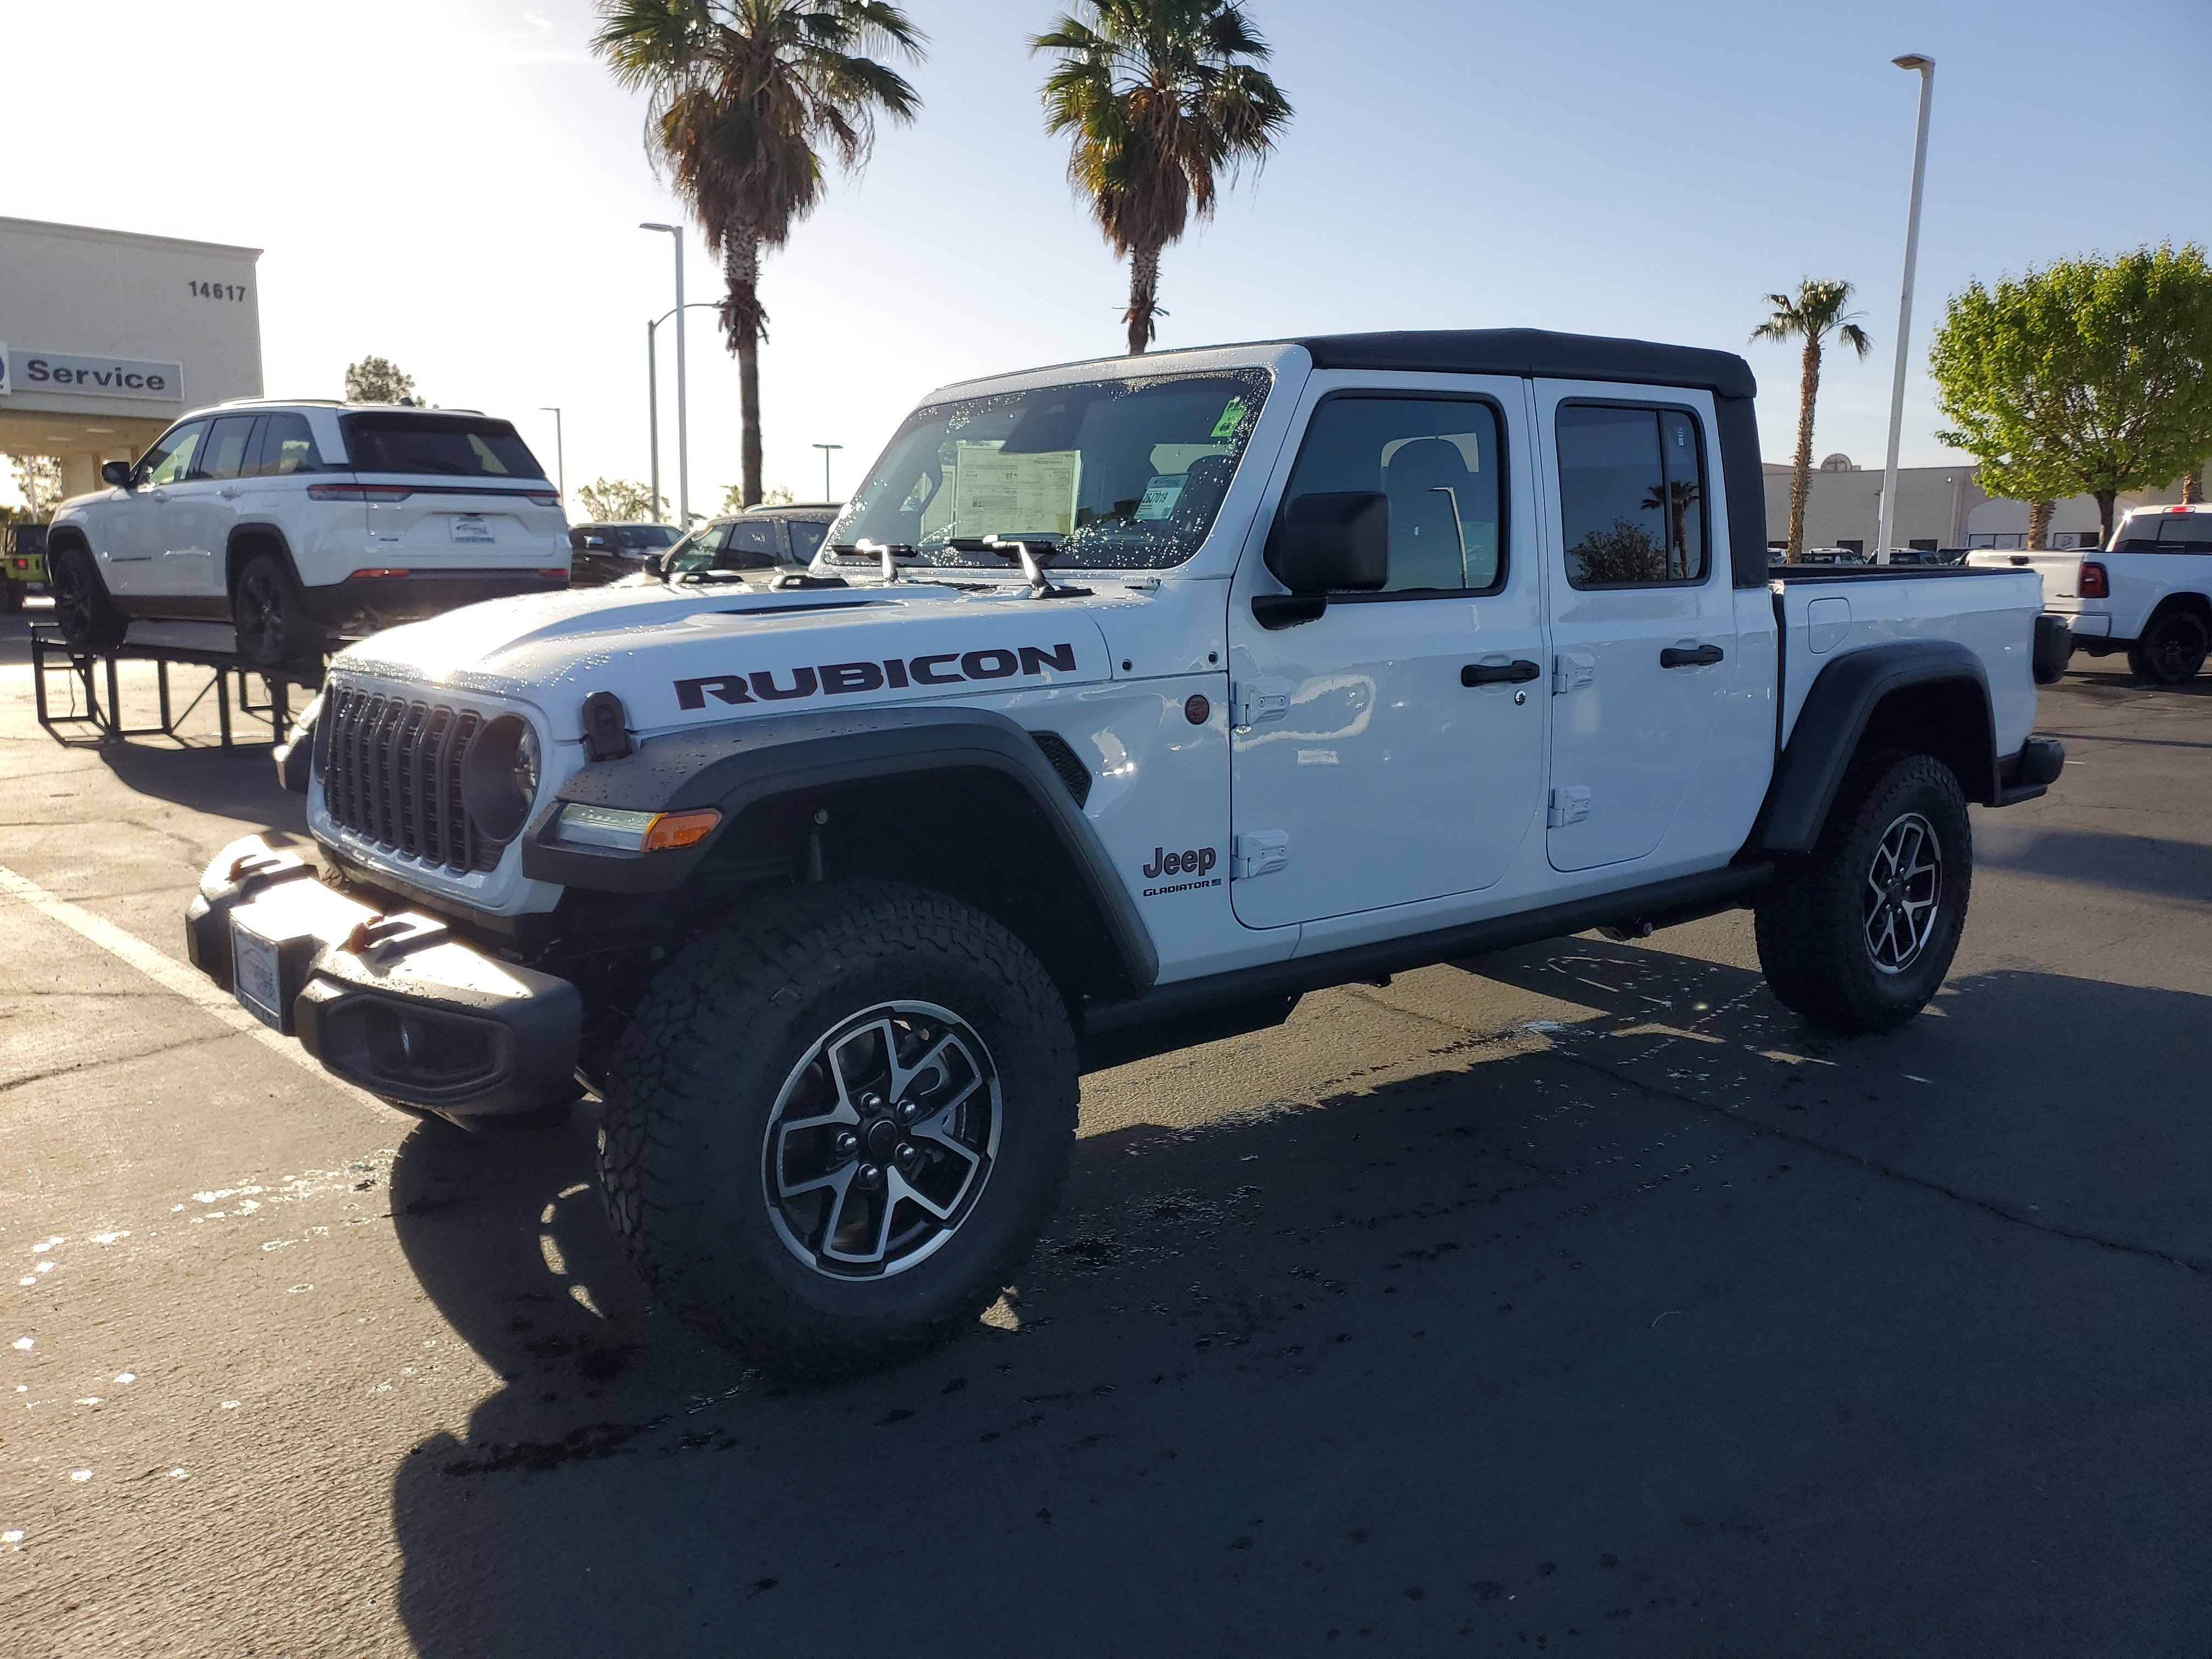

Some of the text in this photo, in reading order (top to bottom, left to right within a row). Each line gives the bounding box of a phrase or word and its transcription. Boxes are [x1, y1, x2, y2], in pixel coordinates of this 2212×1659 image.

[189, 281, 246, 302] 14617
[27, 359, 165, 391] Service
[673, 643, 1077, 710] RUBICON
[1143, 847, 1216, 878] Jeep
[1143, 880, 1210, 897] GLADIATOR
